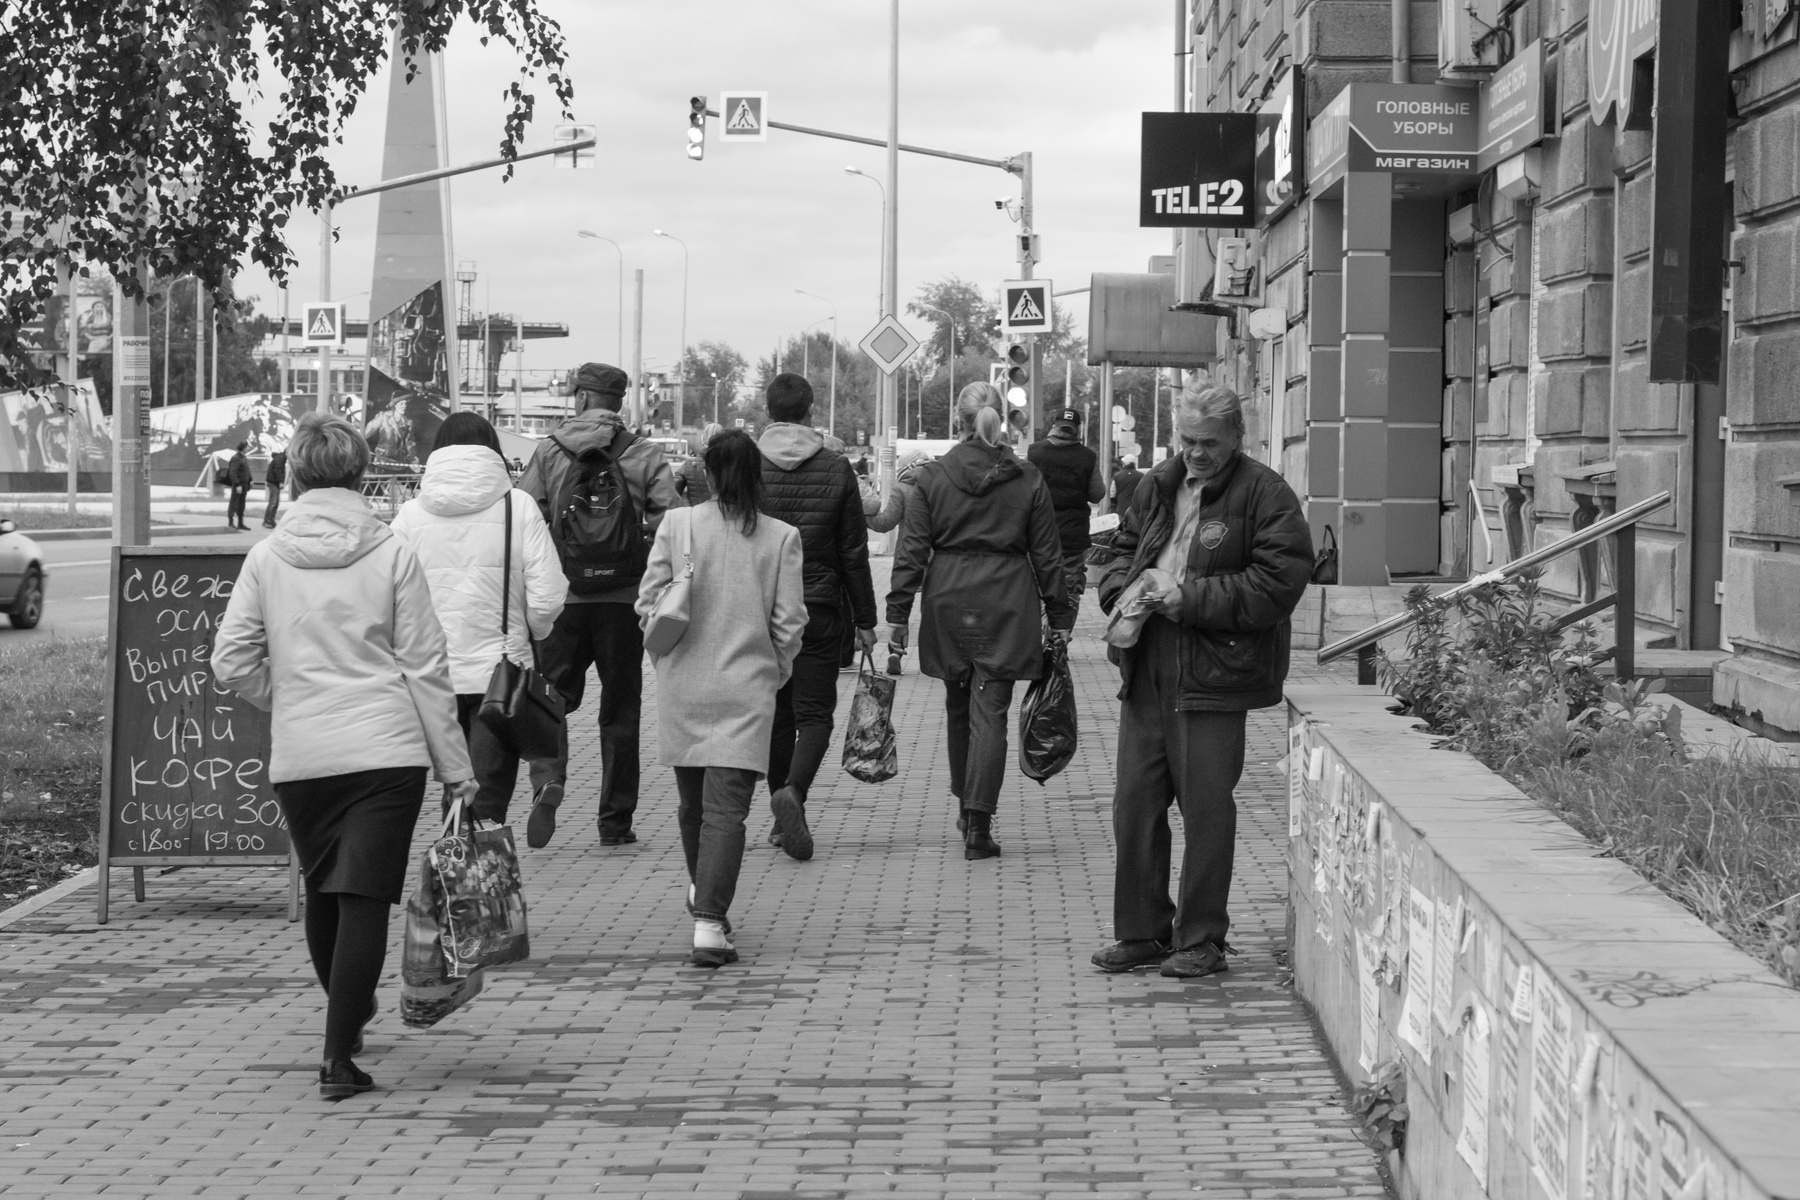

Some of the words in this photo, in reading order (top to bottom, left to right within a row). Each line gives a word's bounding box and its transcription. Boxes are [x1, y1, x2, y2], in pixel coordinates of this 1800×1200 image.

[1376, 101, 1470, 115] ГОЛОВНЫЕ
[1393, 121, 1453, 134] УБОРЫ
[1376, 157, 1470, 169] магазин
[1151, 179, 1244, 215] TELE2
[123, 568, 234, 602] Свеж
[126, 644, 211, 683] Выпе
